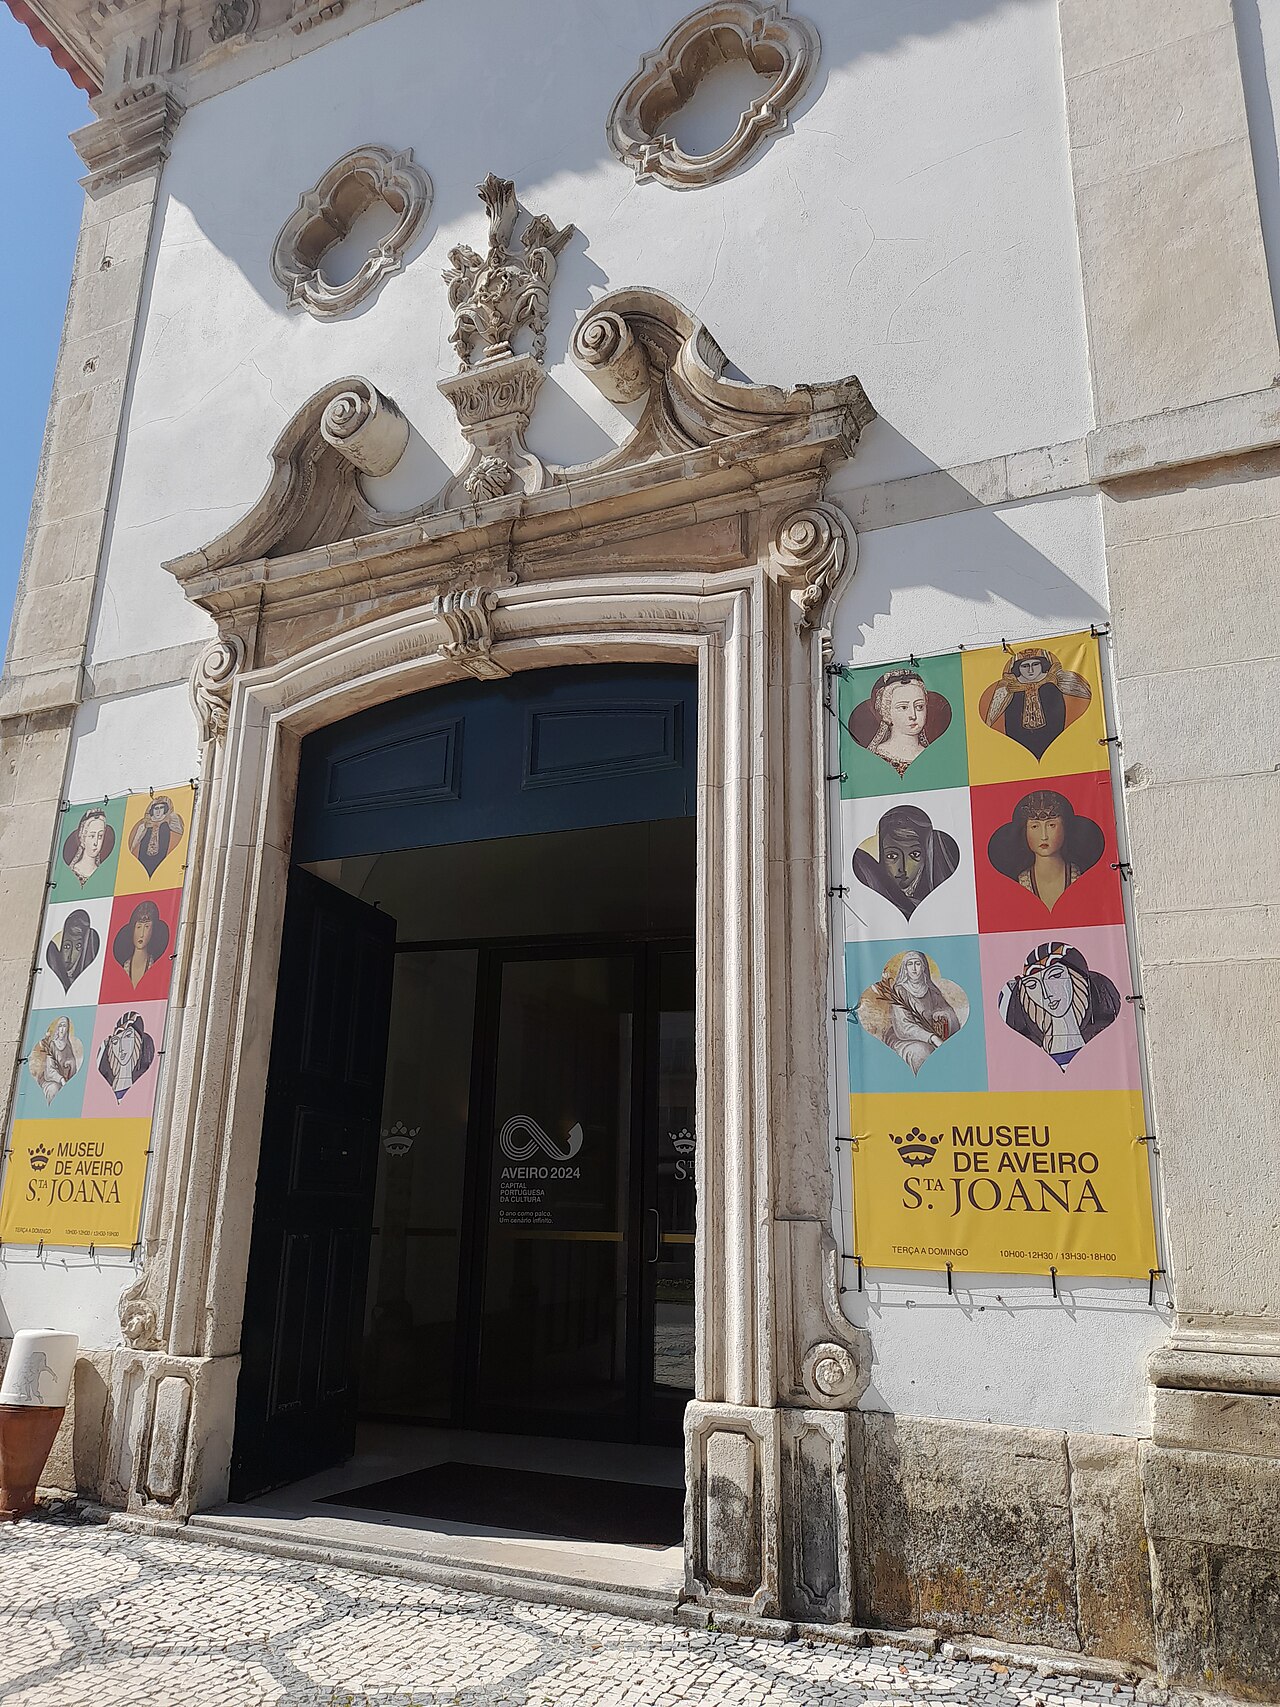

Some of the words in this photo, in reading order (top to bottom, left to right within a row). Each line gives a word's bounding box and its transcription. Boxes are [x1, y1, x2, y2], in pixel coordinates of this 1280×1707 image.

[952, 1126, 1050, 1147] MUSEU
[57, 1142, 105, 1157] MUSEU
[55, 1161, 73, 1176] DE
[75, 1161, 124, 1176] AVEIRO
[953, 1152, 989, 1173] DE
[997, 1152, 1099, 1174] AVEIRO
[501, 1167, 549, 1179] AVEIRO
[550, 1167, 581, 1179] 2024
[47, 1179, 122, 1207] JOANA
[950, 1177, 1108, 1217] JOANA
[534, 1210, 553, 1218] palco.
[892, 1246, 921, 1255] TERÇA
[921, 1247, 927, 1255] A
[928, 1247, 969, 1257] DOMINGO
[1000, 1250, 1053, 1260] 10H00-12H30
[1060, 1252, 1117, 1261] 13H30-18H00
